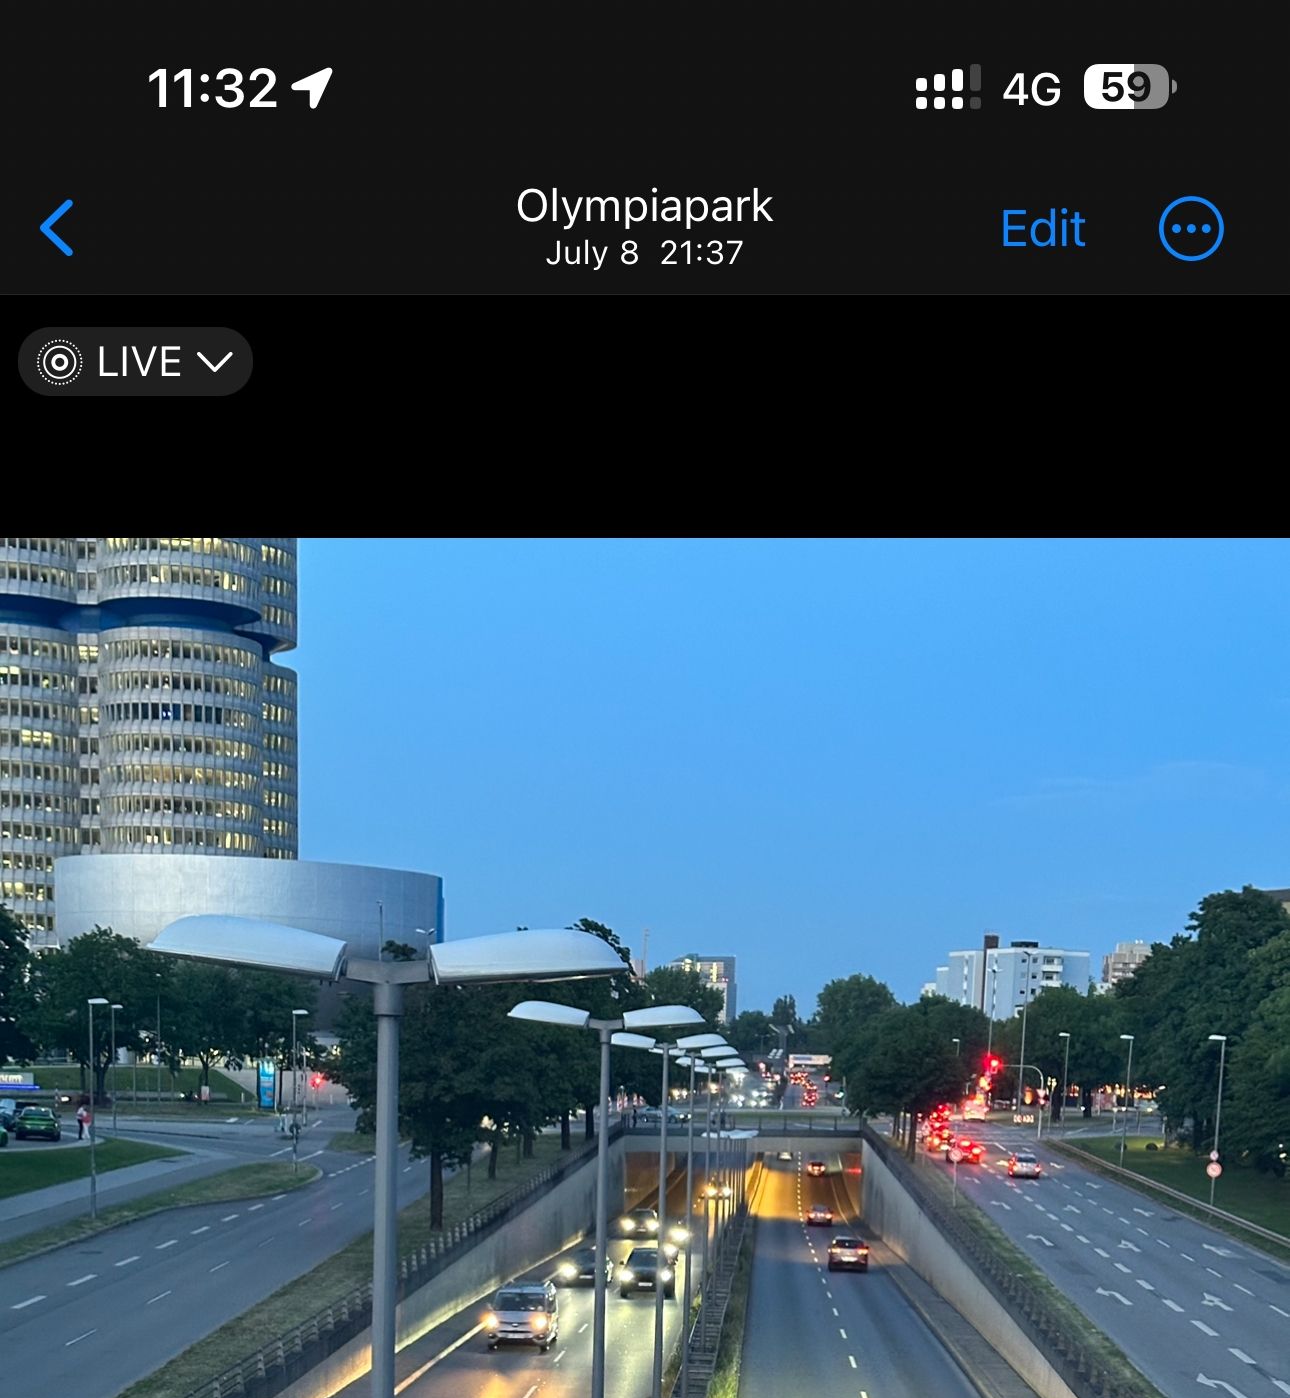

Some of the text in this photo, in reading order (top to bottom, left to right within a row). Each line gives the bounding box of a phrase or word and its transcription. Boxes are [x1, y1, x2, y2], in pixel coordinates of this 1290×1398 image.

[148, 67, 278, 109] 11:32
[1002, 71, 1061, 107] 4G
[1101, 71, 1151, 102] 59
[517, 186, 774, 231] Olympiapark
[1002, 207, 1086, 248] Edit
[545, 239, 744, 271] July 8 21:37
[99, 345, 181, 377] LIVE
